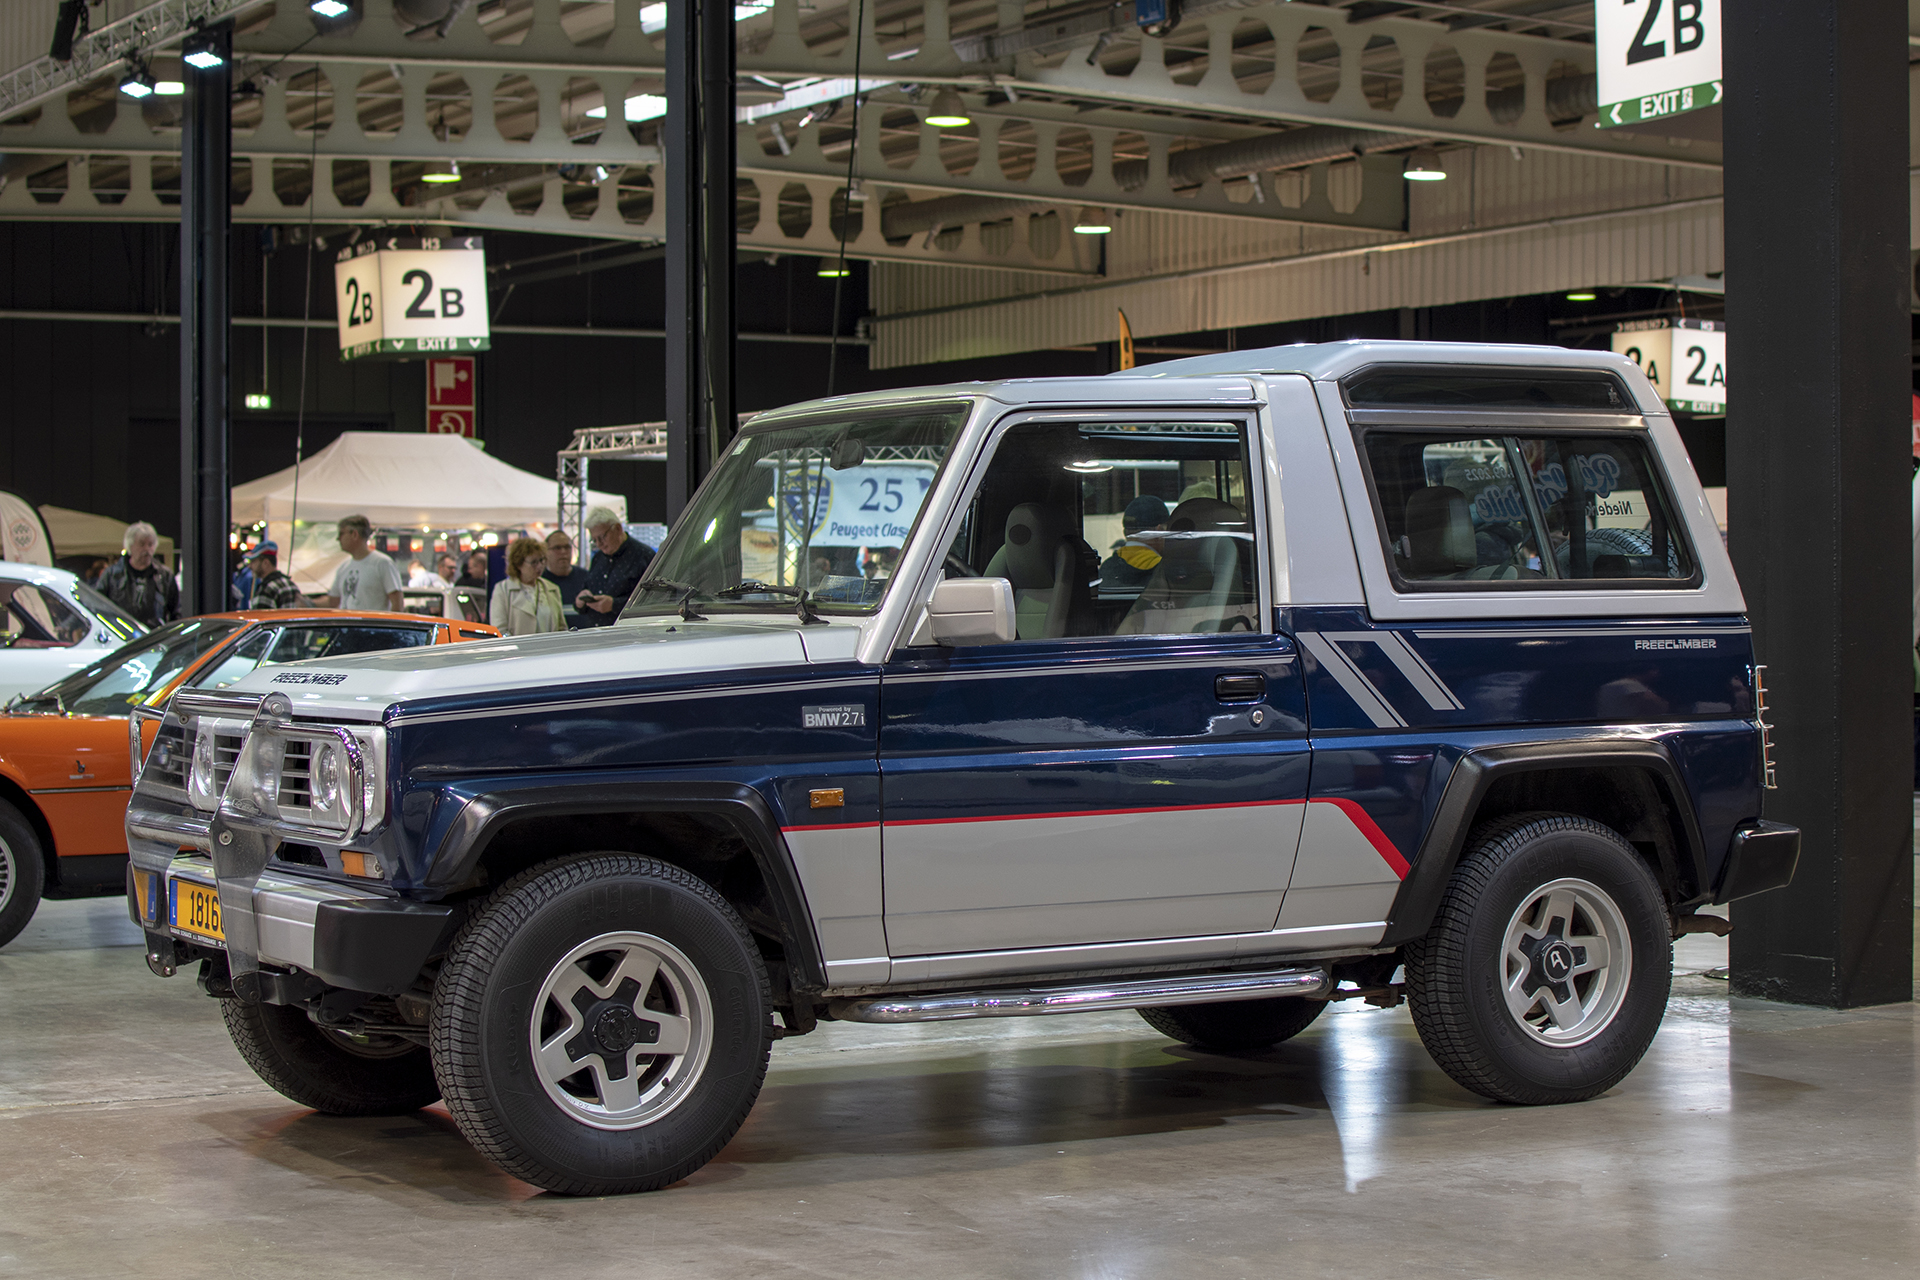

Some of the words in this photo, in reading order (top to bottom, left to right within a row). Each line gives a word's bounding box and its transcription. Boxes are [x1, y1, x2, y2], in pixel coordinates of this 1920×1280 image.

[1623, 0, 1705, 66] 2B
[1640, 90, 1680, 119] EXIT
[422, 238, 440, 250] H3
[346, 277, 373, 328] 2B
[402, 269, 465, 319] 2B
[417, 338, 446, 350] EXIT
[1686, 346, 1726, 387] 2A
[859, 477, 904, 513] 25
[830, 522, 879, 540] Peugeot
[805, 713, 840, 727] BMW
